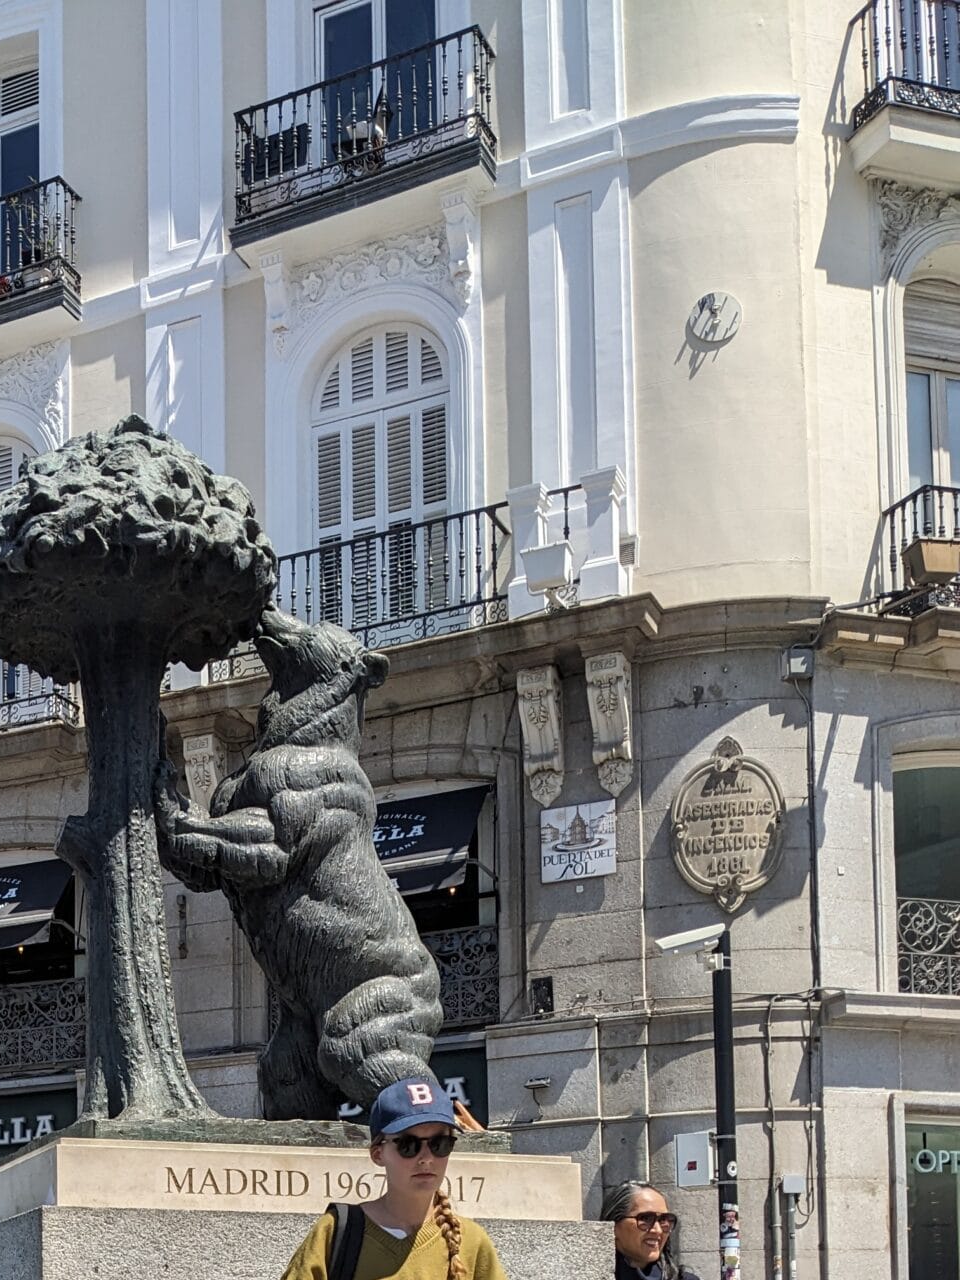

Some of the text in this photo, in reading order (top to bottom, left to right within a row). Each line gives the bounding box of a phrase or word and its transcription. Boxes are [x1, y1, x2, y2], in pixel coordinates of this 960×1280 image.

[378, 813, 427, 821] IGINALES
[683, 800, 773, 822] ASEGURADAS
[379, 841, 418, 857] TESANA
[683, 833, 770, 857] INCENDIOS
[543, 849, 613, 867] PUERTA DEL
[556, 861, 596, 880] SOL
[407, 1083, 433, 1105] B
[164, 1166, 310, 1197] MADRID
[322, 1171, 388, 1199] 1967
